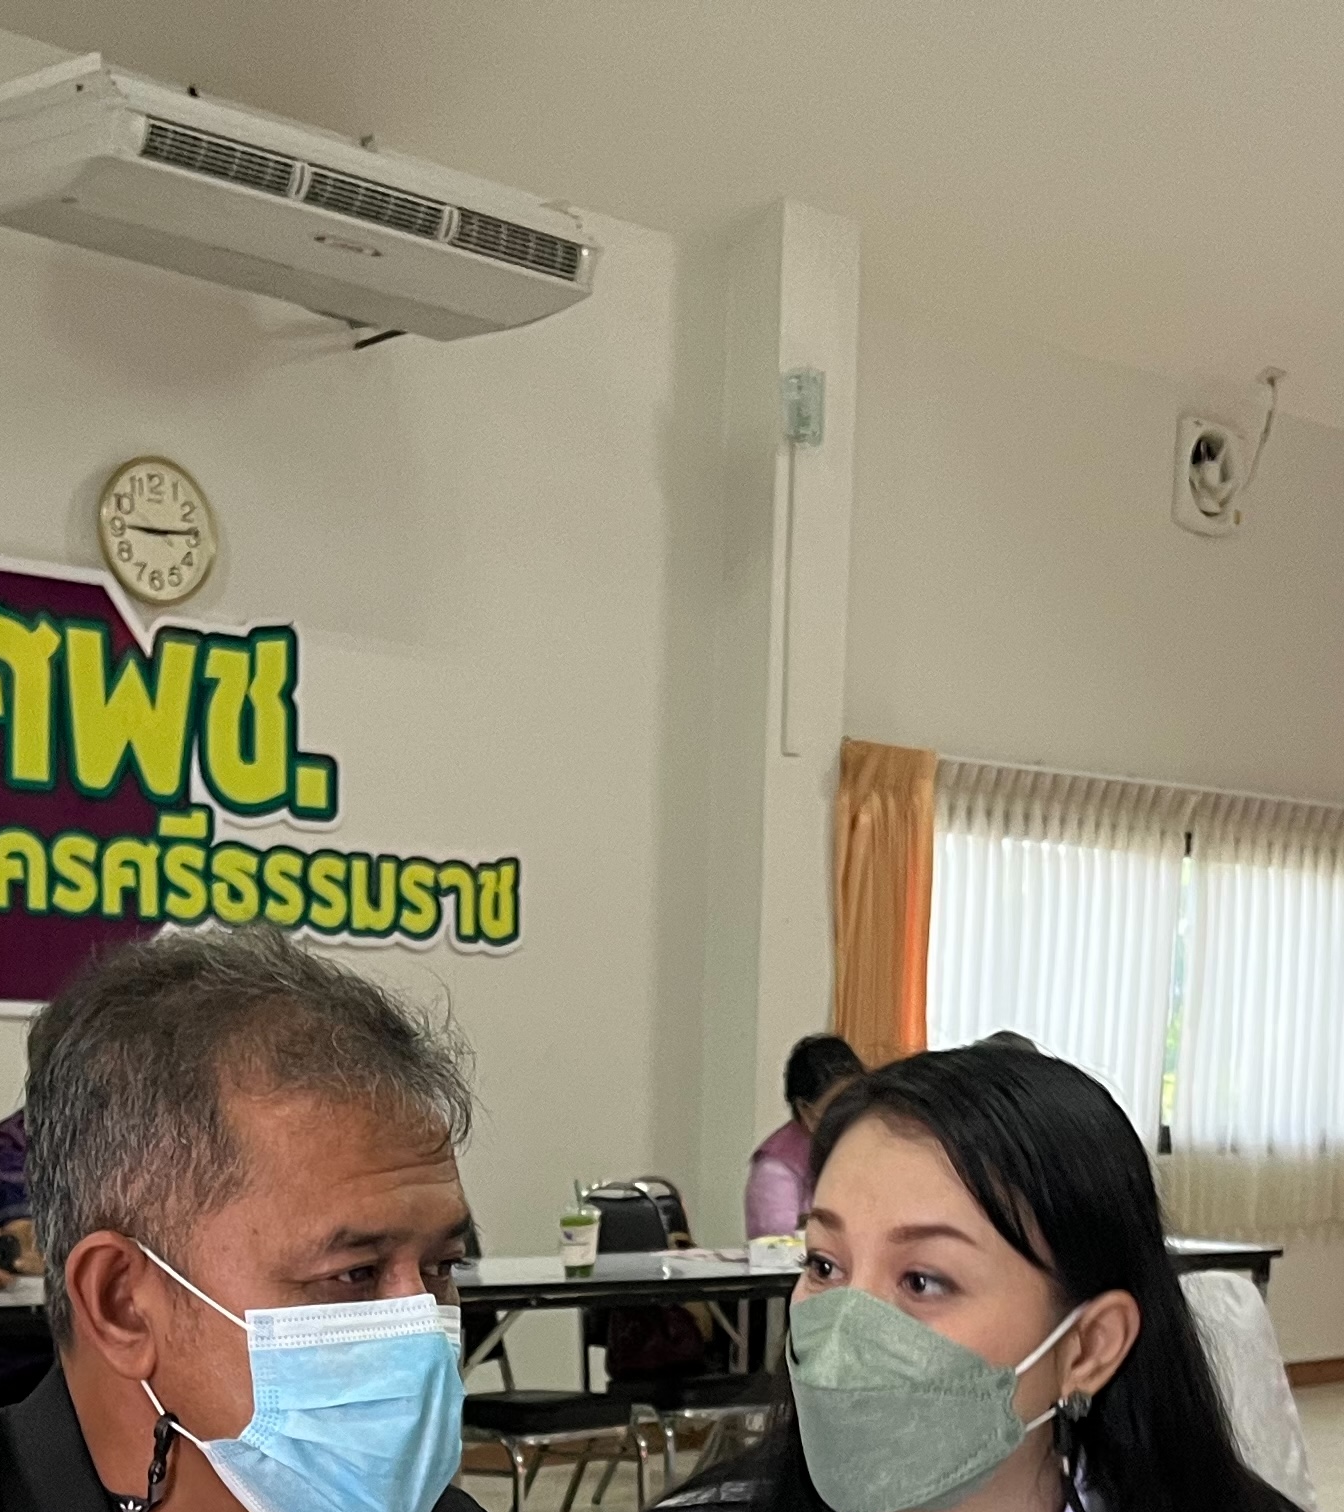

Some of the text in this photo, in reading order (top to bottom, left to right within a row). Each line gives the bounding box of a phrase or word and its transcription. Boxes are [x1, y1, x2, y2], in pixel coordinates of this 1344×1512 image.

[129, 475, 145, 498] 11
[146, 471, 165, 496] 12
[171, 480, 180, 501] 1
[113, 492, 135, 515] 10
[180, 501, 197, 523] 2
[110, 515, 127, 538] 9
[185, 526, 201, 548] 3
[117, 538, 134, 562] 8
[180, 551, 194, 567] 4
[133, 561, 148, 582] 7
[149, 569, 166, 592] 6
[167, 565, 183, 588] 5
